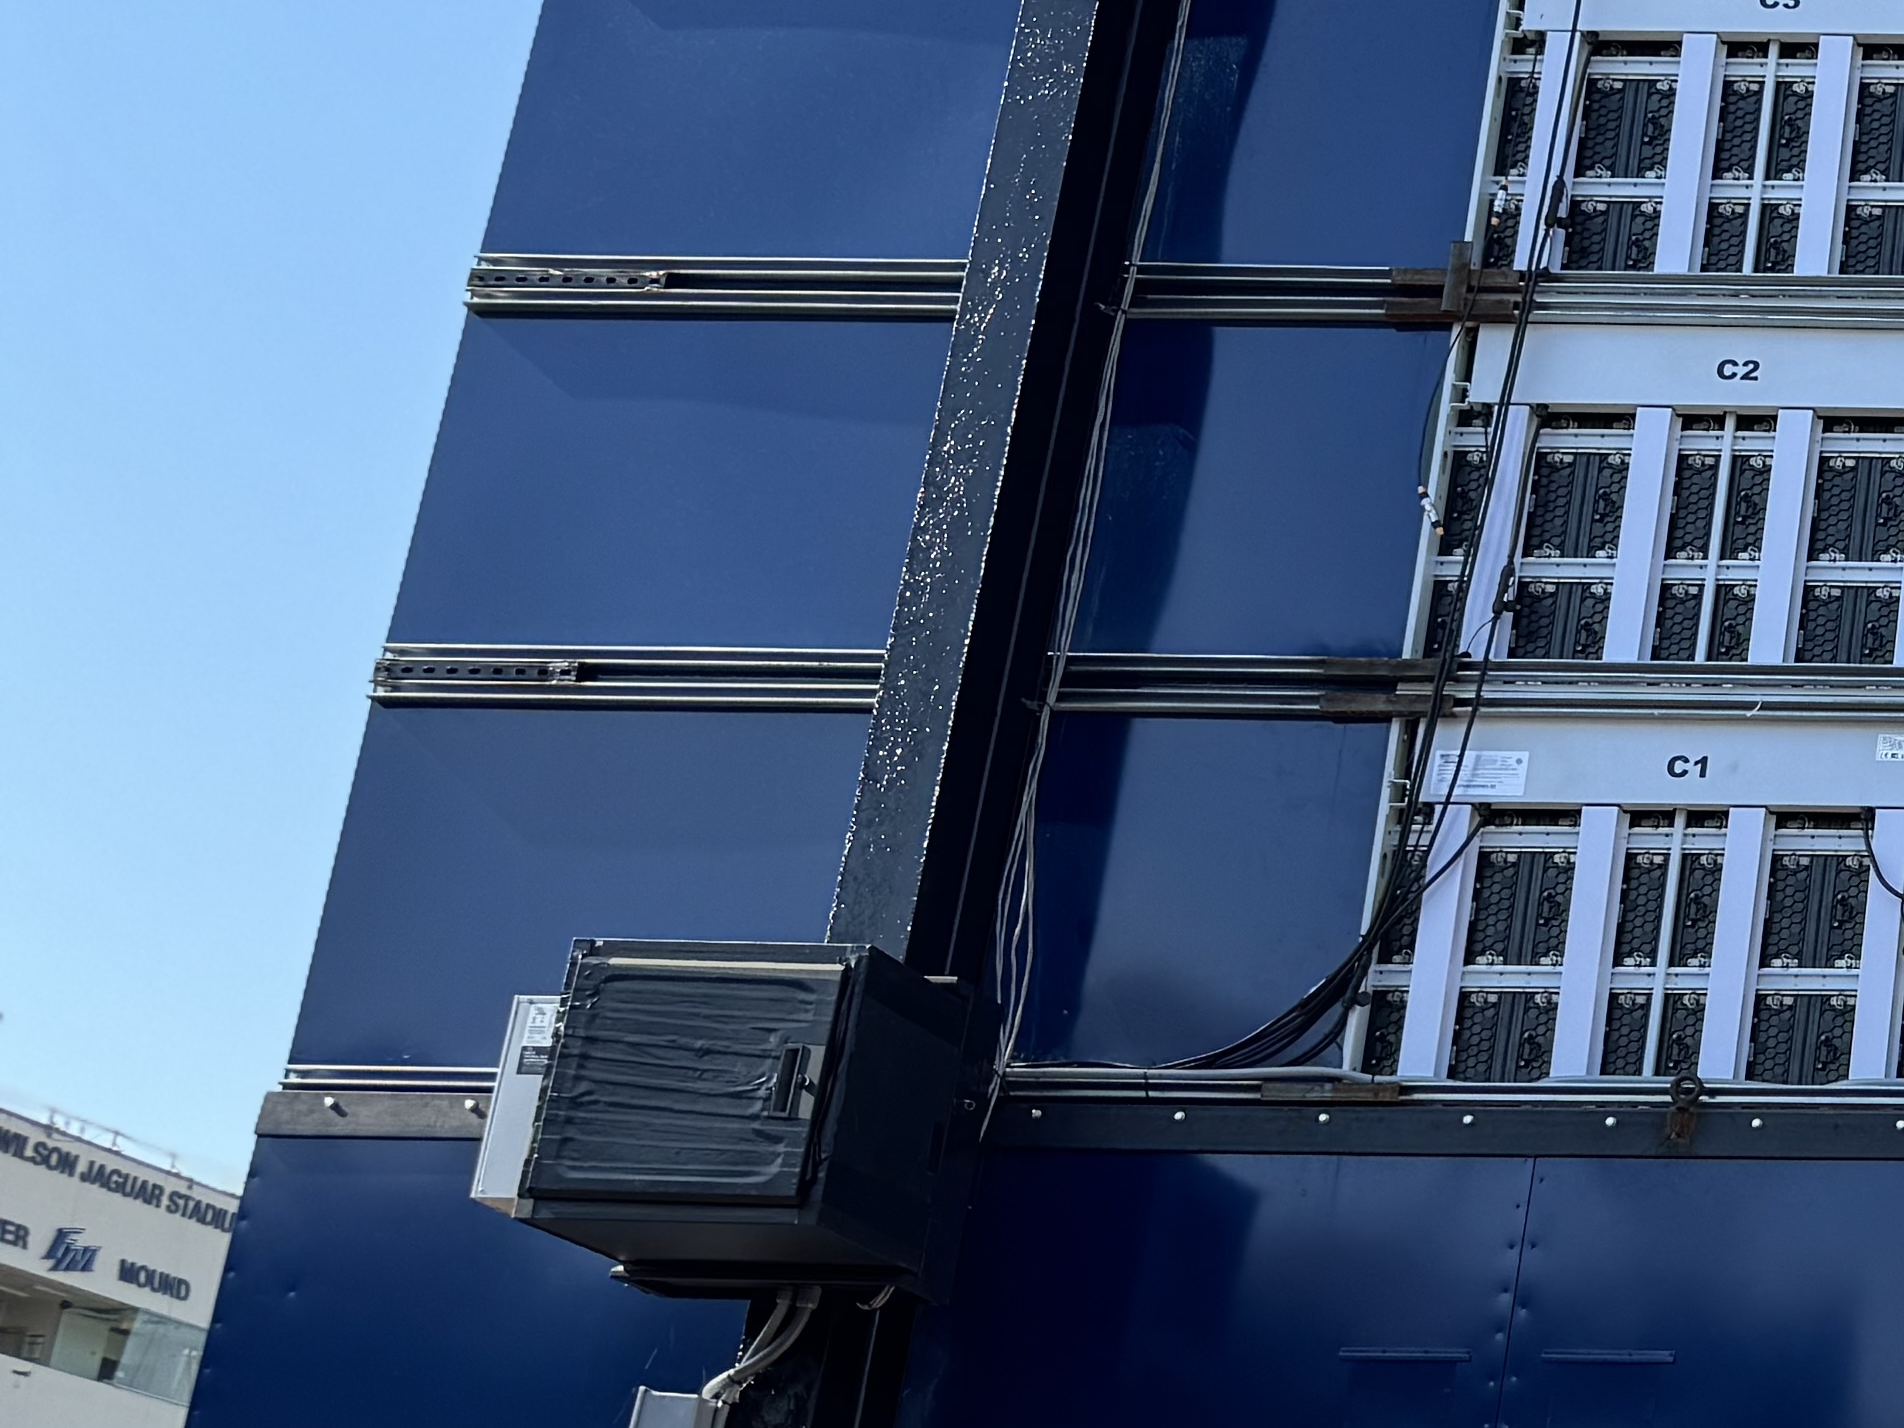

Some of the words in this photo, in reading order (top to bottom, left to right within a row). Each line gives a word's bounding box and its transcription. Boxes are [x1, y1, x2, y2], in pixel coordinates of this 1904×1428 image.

[1717, 359, 1760, 382] C2
[1667, 756, 1709, 779] C1
[80, 1160, 165, 1209] JAGUAR
[118, 1258, 192, 1302] MOUND
